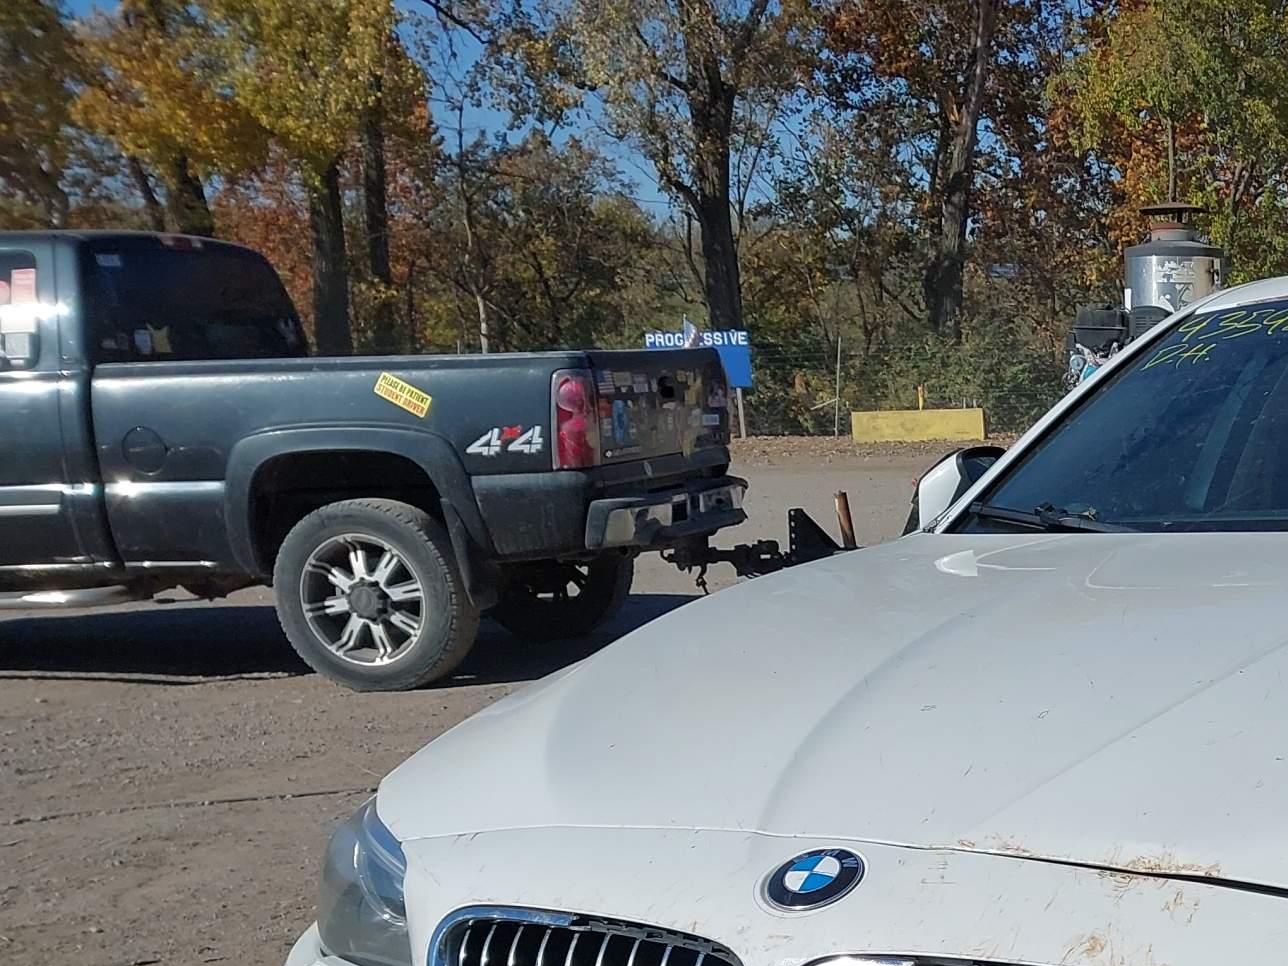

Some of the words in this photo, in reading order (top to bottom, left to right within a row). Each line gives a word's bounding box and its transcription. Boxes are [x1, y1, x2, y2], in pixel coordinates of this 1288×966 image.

[644, 331, 748, 348] PROGSSIVE
[376, 383, 403, 403] STUDENT
[402, 397, 426, 415] DRIVER
[380, 375, 400, 390] PLEASE
[406, 388, 429, 406] PATIENT
